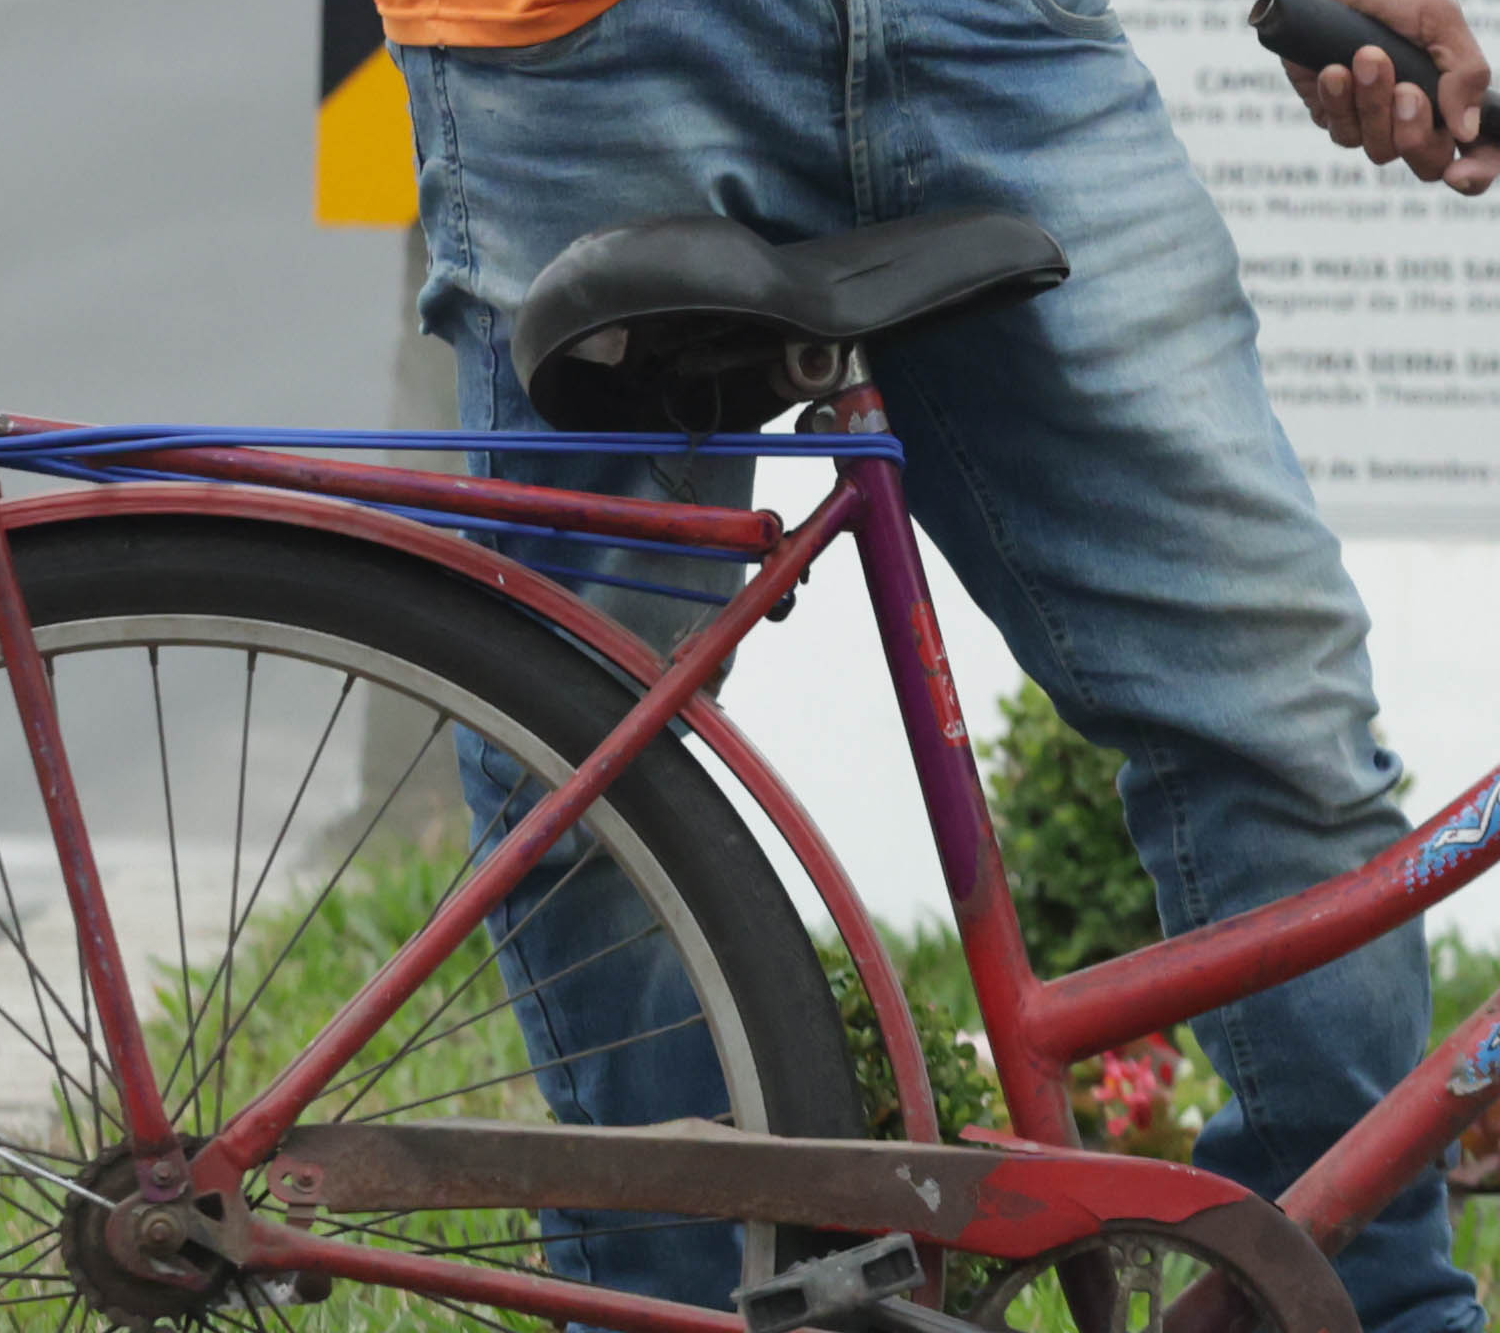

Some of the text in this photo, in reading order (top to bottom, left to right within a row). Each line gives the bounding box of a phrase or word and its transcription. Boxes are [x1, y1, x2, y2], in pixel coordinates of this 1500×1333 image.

[1396, 257, 1451, 282] DOS
[1367, 351, 1457, 375] SERRA
[1368, 457, 1489, 481] Setembro
